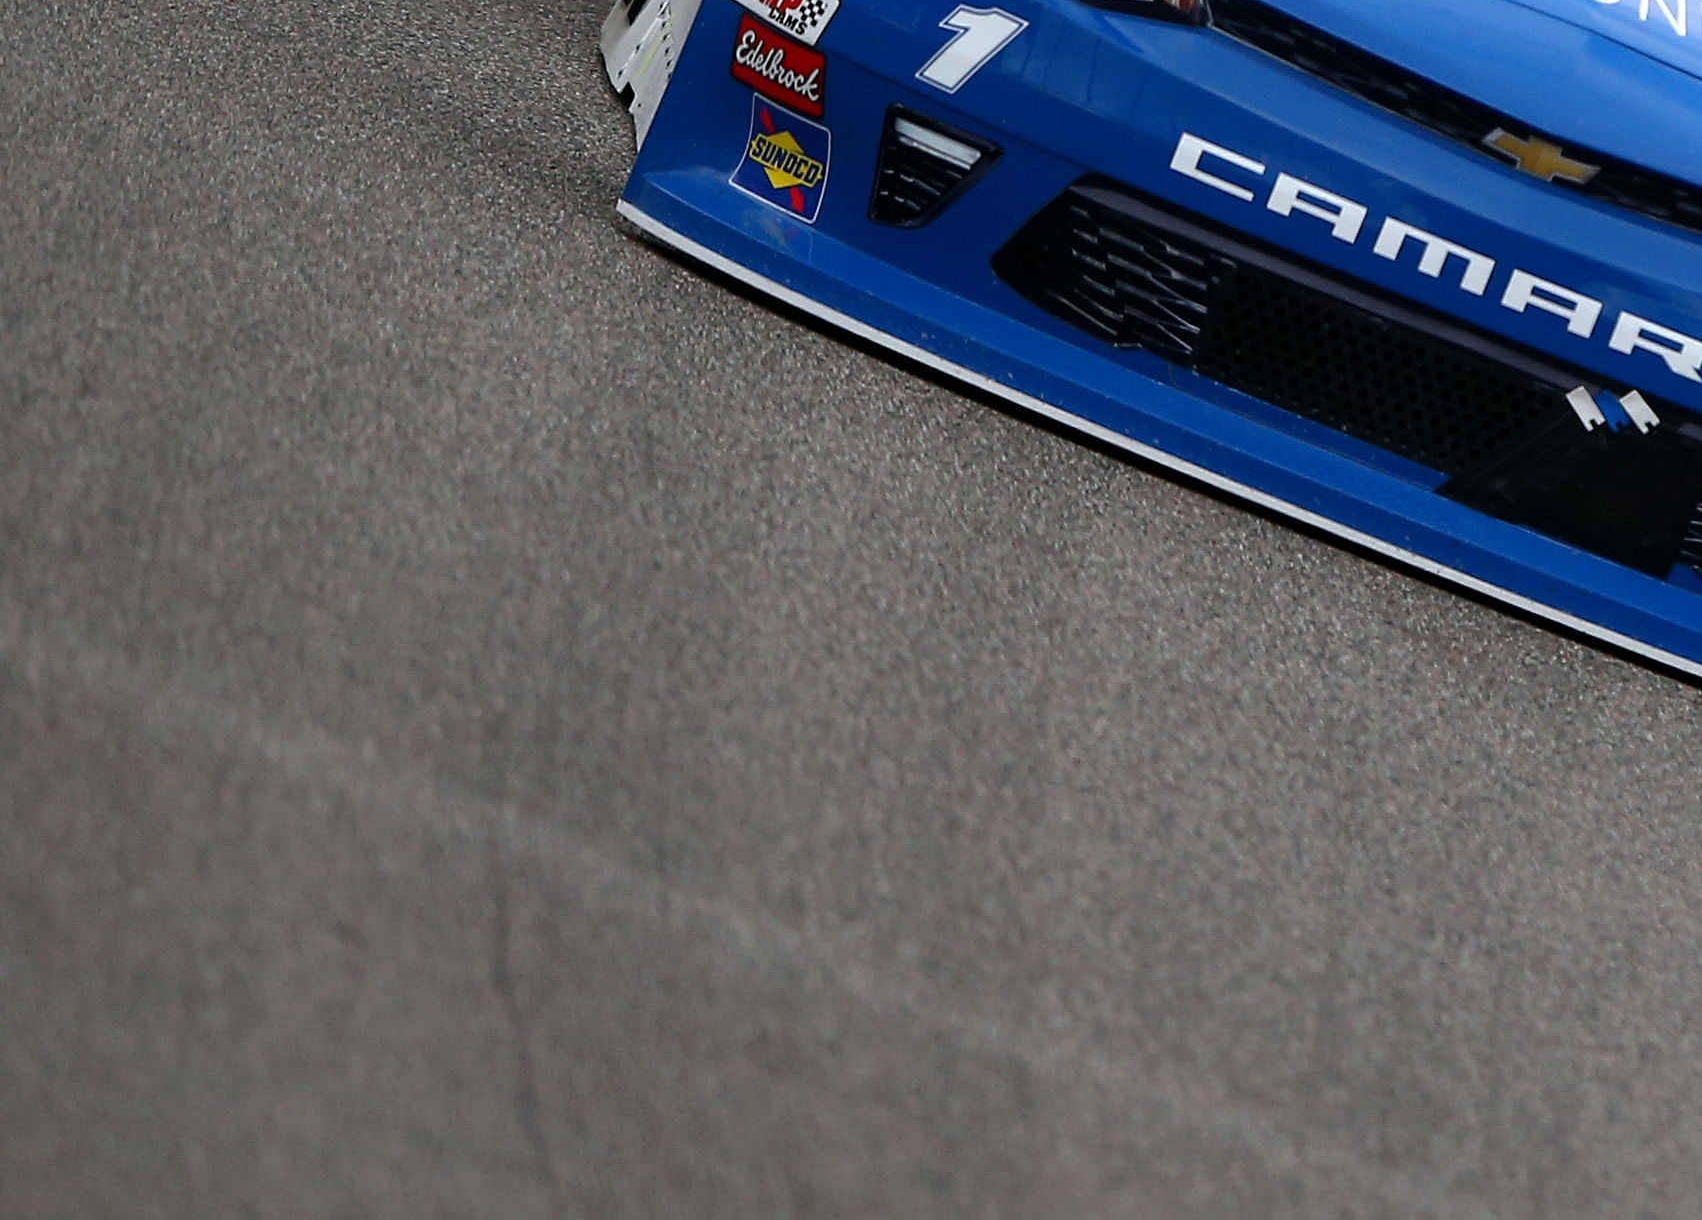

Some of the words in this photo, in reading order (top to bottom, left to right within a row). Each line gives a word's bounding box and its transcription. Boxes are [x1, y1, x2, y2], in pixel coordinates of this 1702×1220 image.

[768, 6, 809, 36] CAMS
[915, 5, 1029, 94] 1
[735, 30, 820, 101] Edelbrock
[751, 135, 821, 184] SUNOCO
